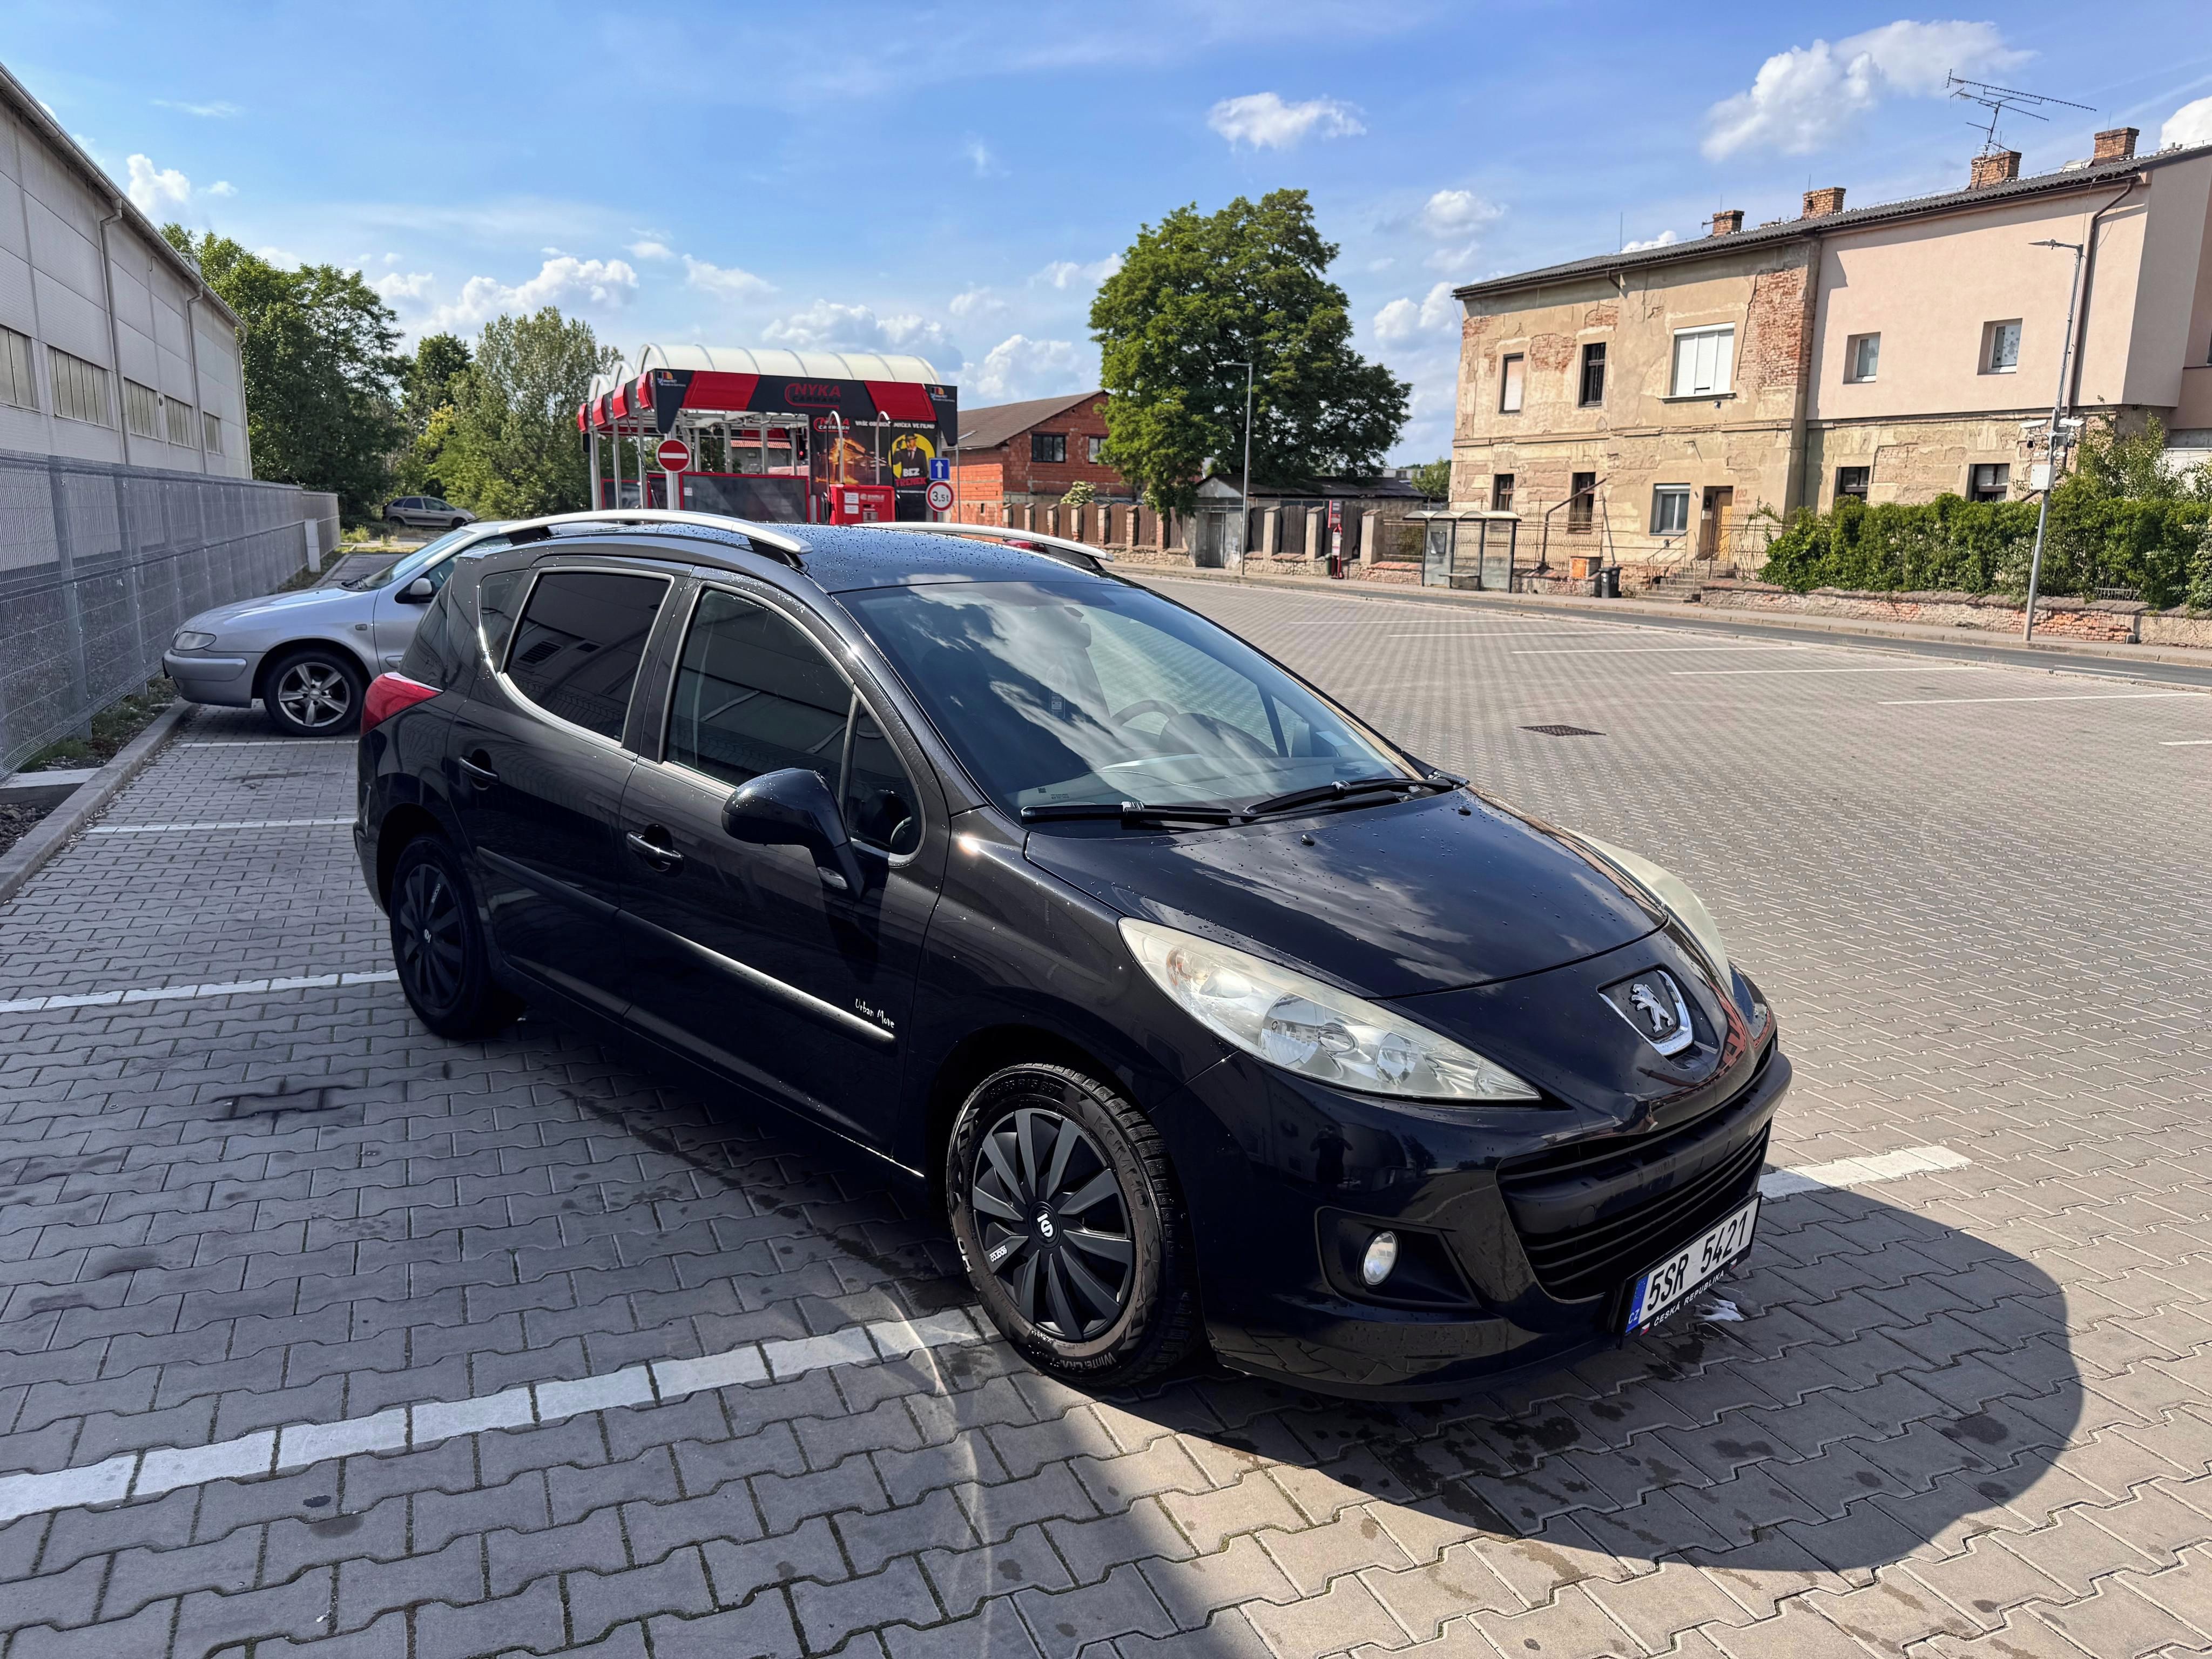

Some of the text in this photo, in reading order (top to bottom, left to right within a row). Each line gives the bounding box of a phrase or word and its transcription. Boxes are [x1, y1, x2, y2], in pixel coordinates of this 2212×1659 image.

[795, 383, 841, 397] NYKA
[903, 468, 920, 477] BEZ
[855, 998, 874, 1017] Urban
[1647, 1211, 1748, 1311] 5SR 5421
[1654, 1270, 1724, 1326] ČESKÁ REPUBLIKA
[1628, 1309, 1640, 1324] CZ
